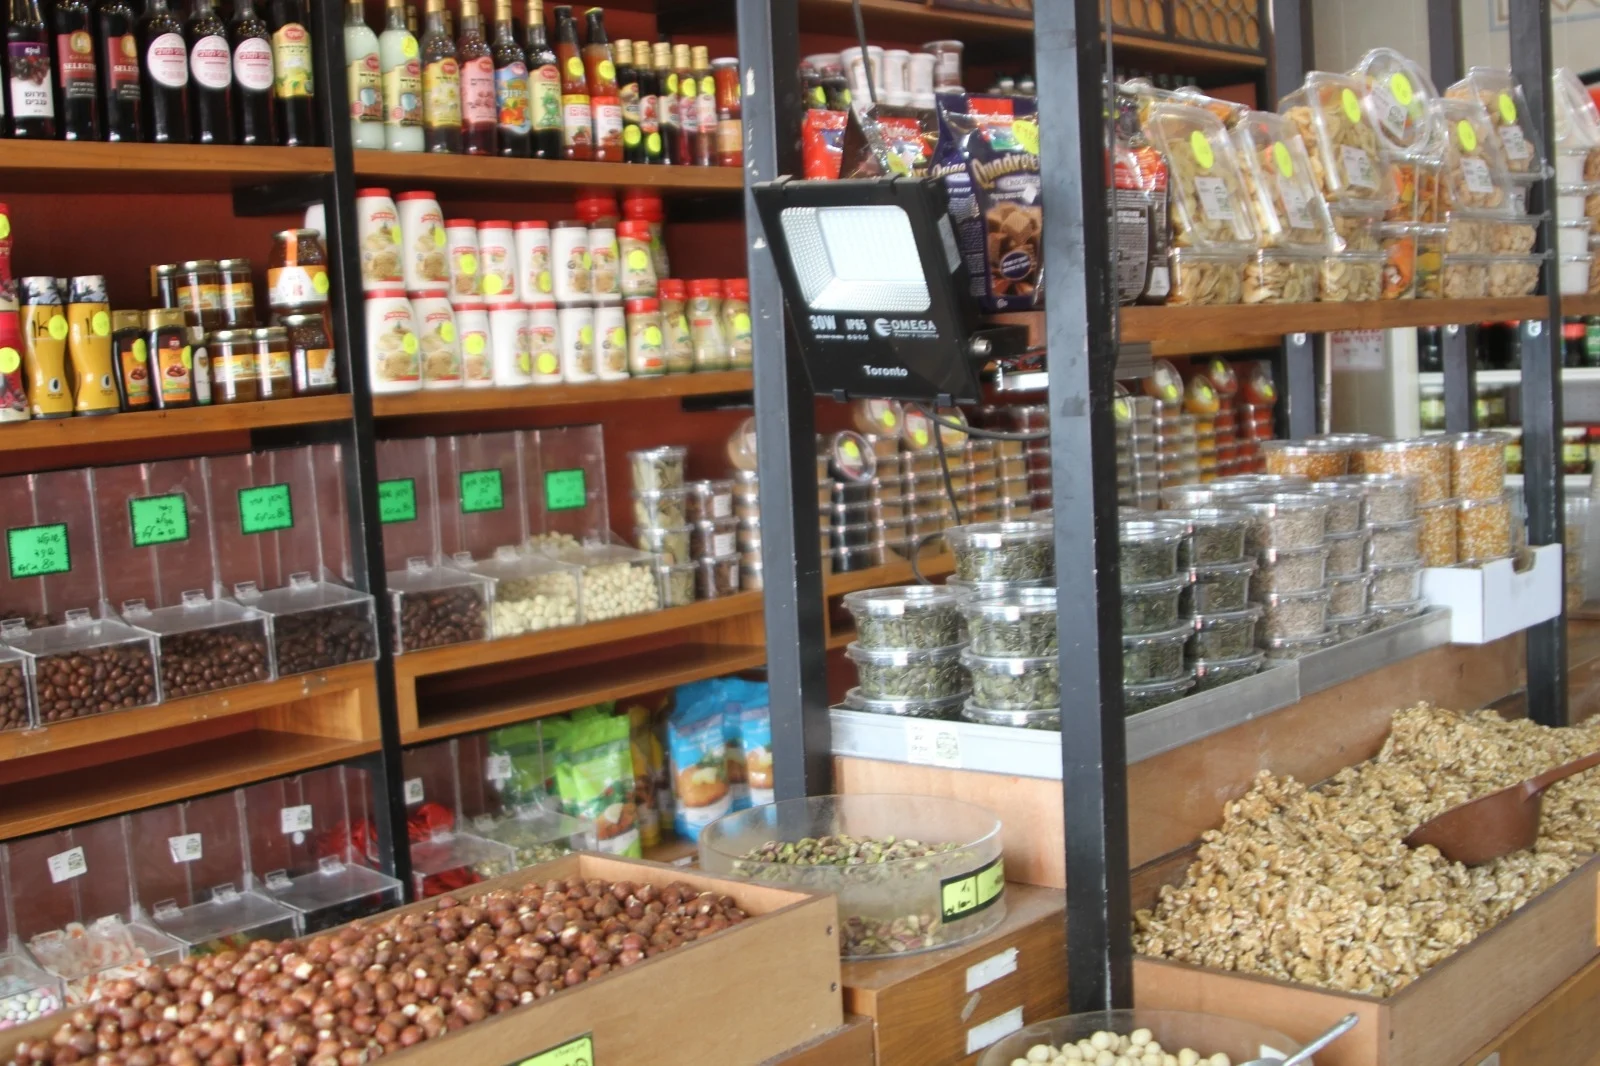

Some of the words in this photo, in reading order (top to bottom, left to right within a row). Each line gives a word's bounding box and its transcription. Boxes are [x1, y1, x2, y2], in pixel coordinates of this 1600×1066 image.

[808, 315, 837, 331] 30W
[845, 318, 868, 331] IP65
[891, 319, 938, 331] OMEGA
[863, 364, 909, 377] Toronto
